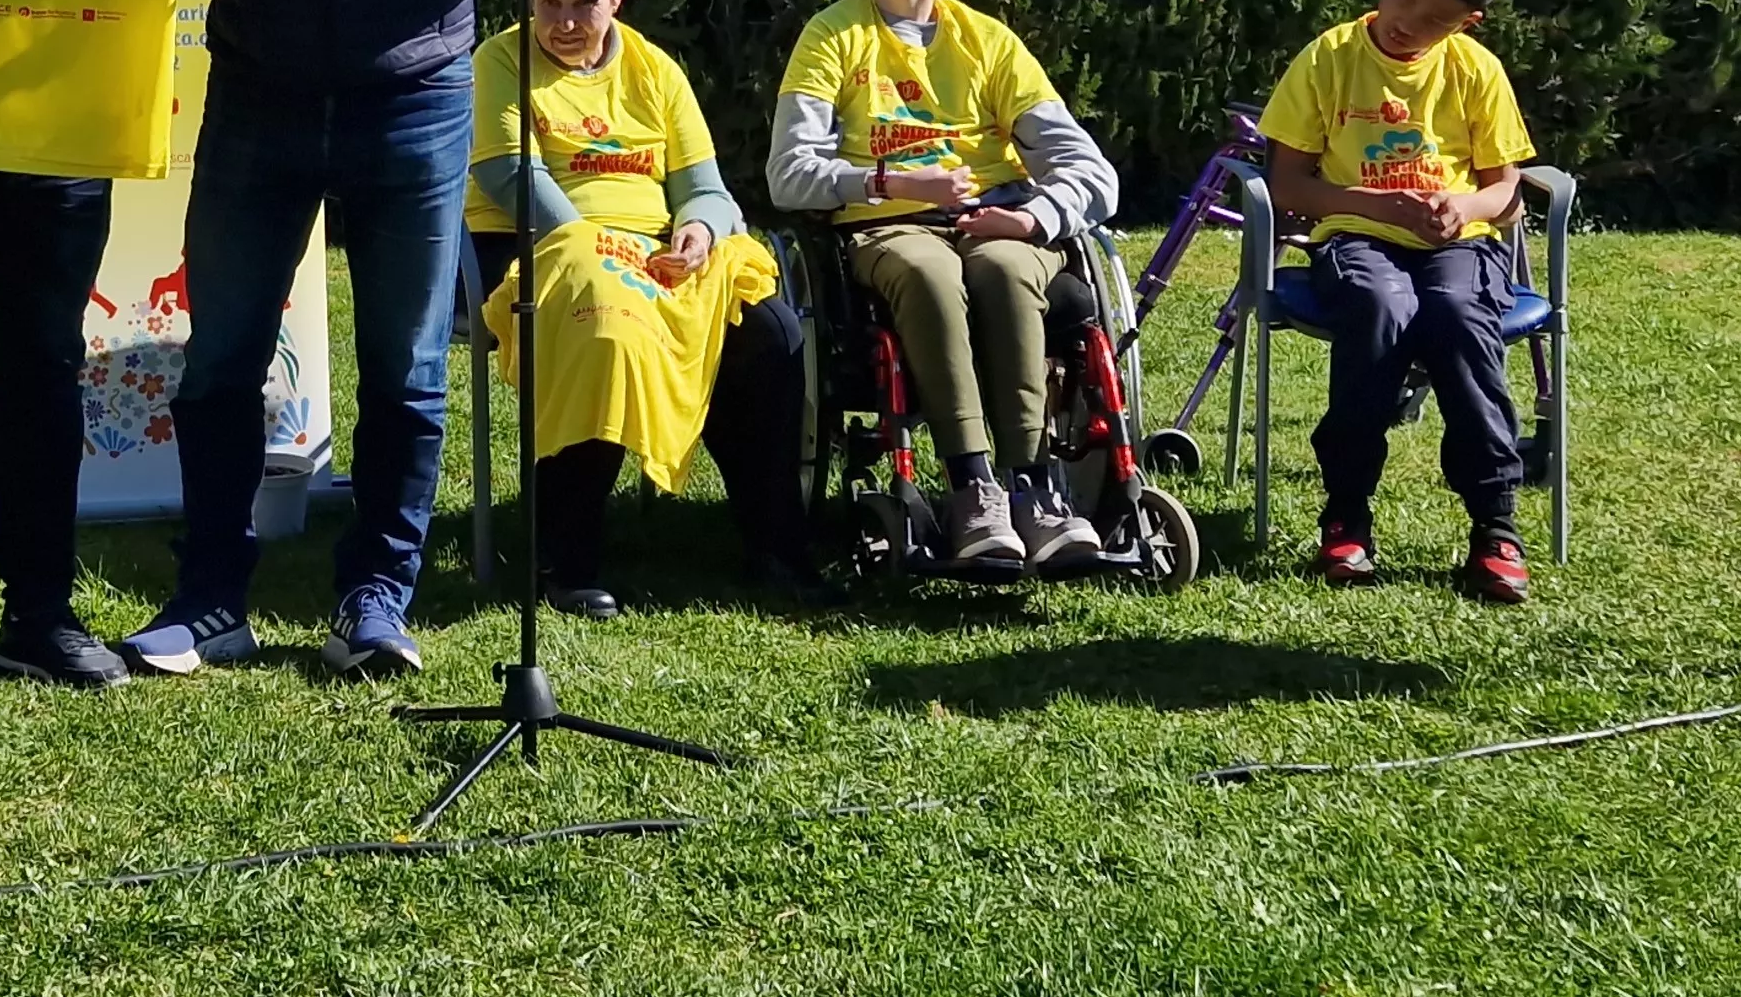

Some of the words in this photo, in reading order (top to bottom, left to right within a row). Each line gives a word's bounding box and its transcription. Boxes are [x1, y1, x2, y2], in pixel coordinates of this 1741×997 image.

[870, 124, 887, 139] LA
[1360, 161, 1379, 178] LA
[596, 232, 614, 247] LA
